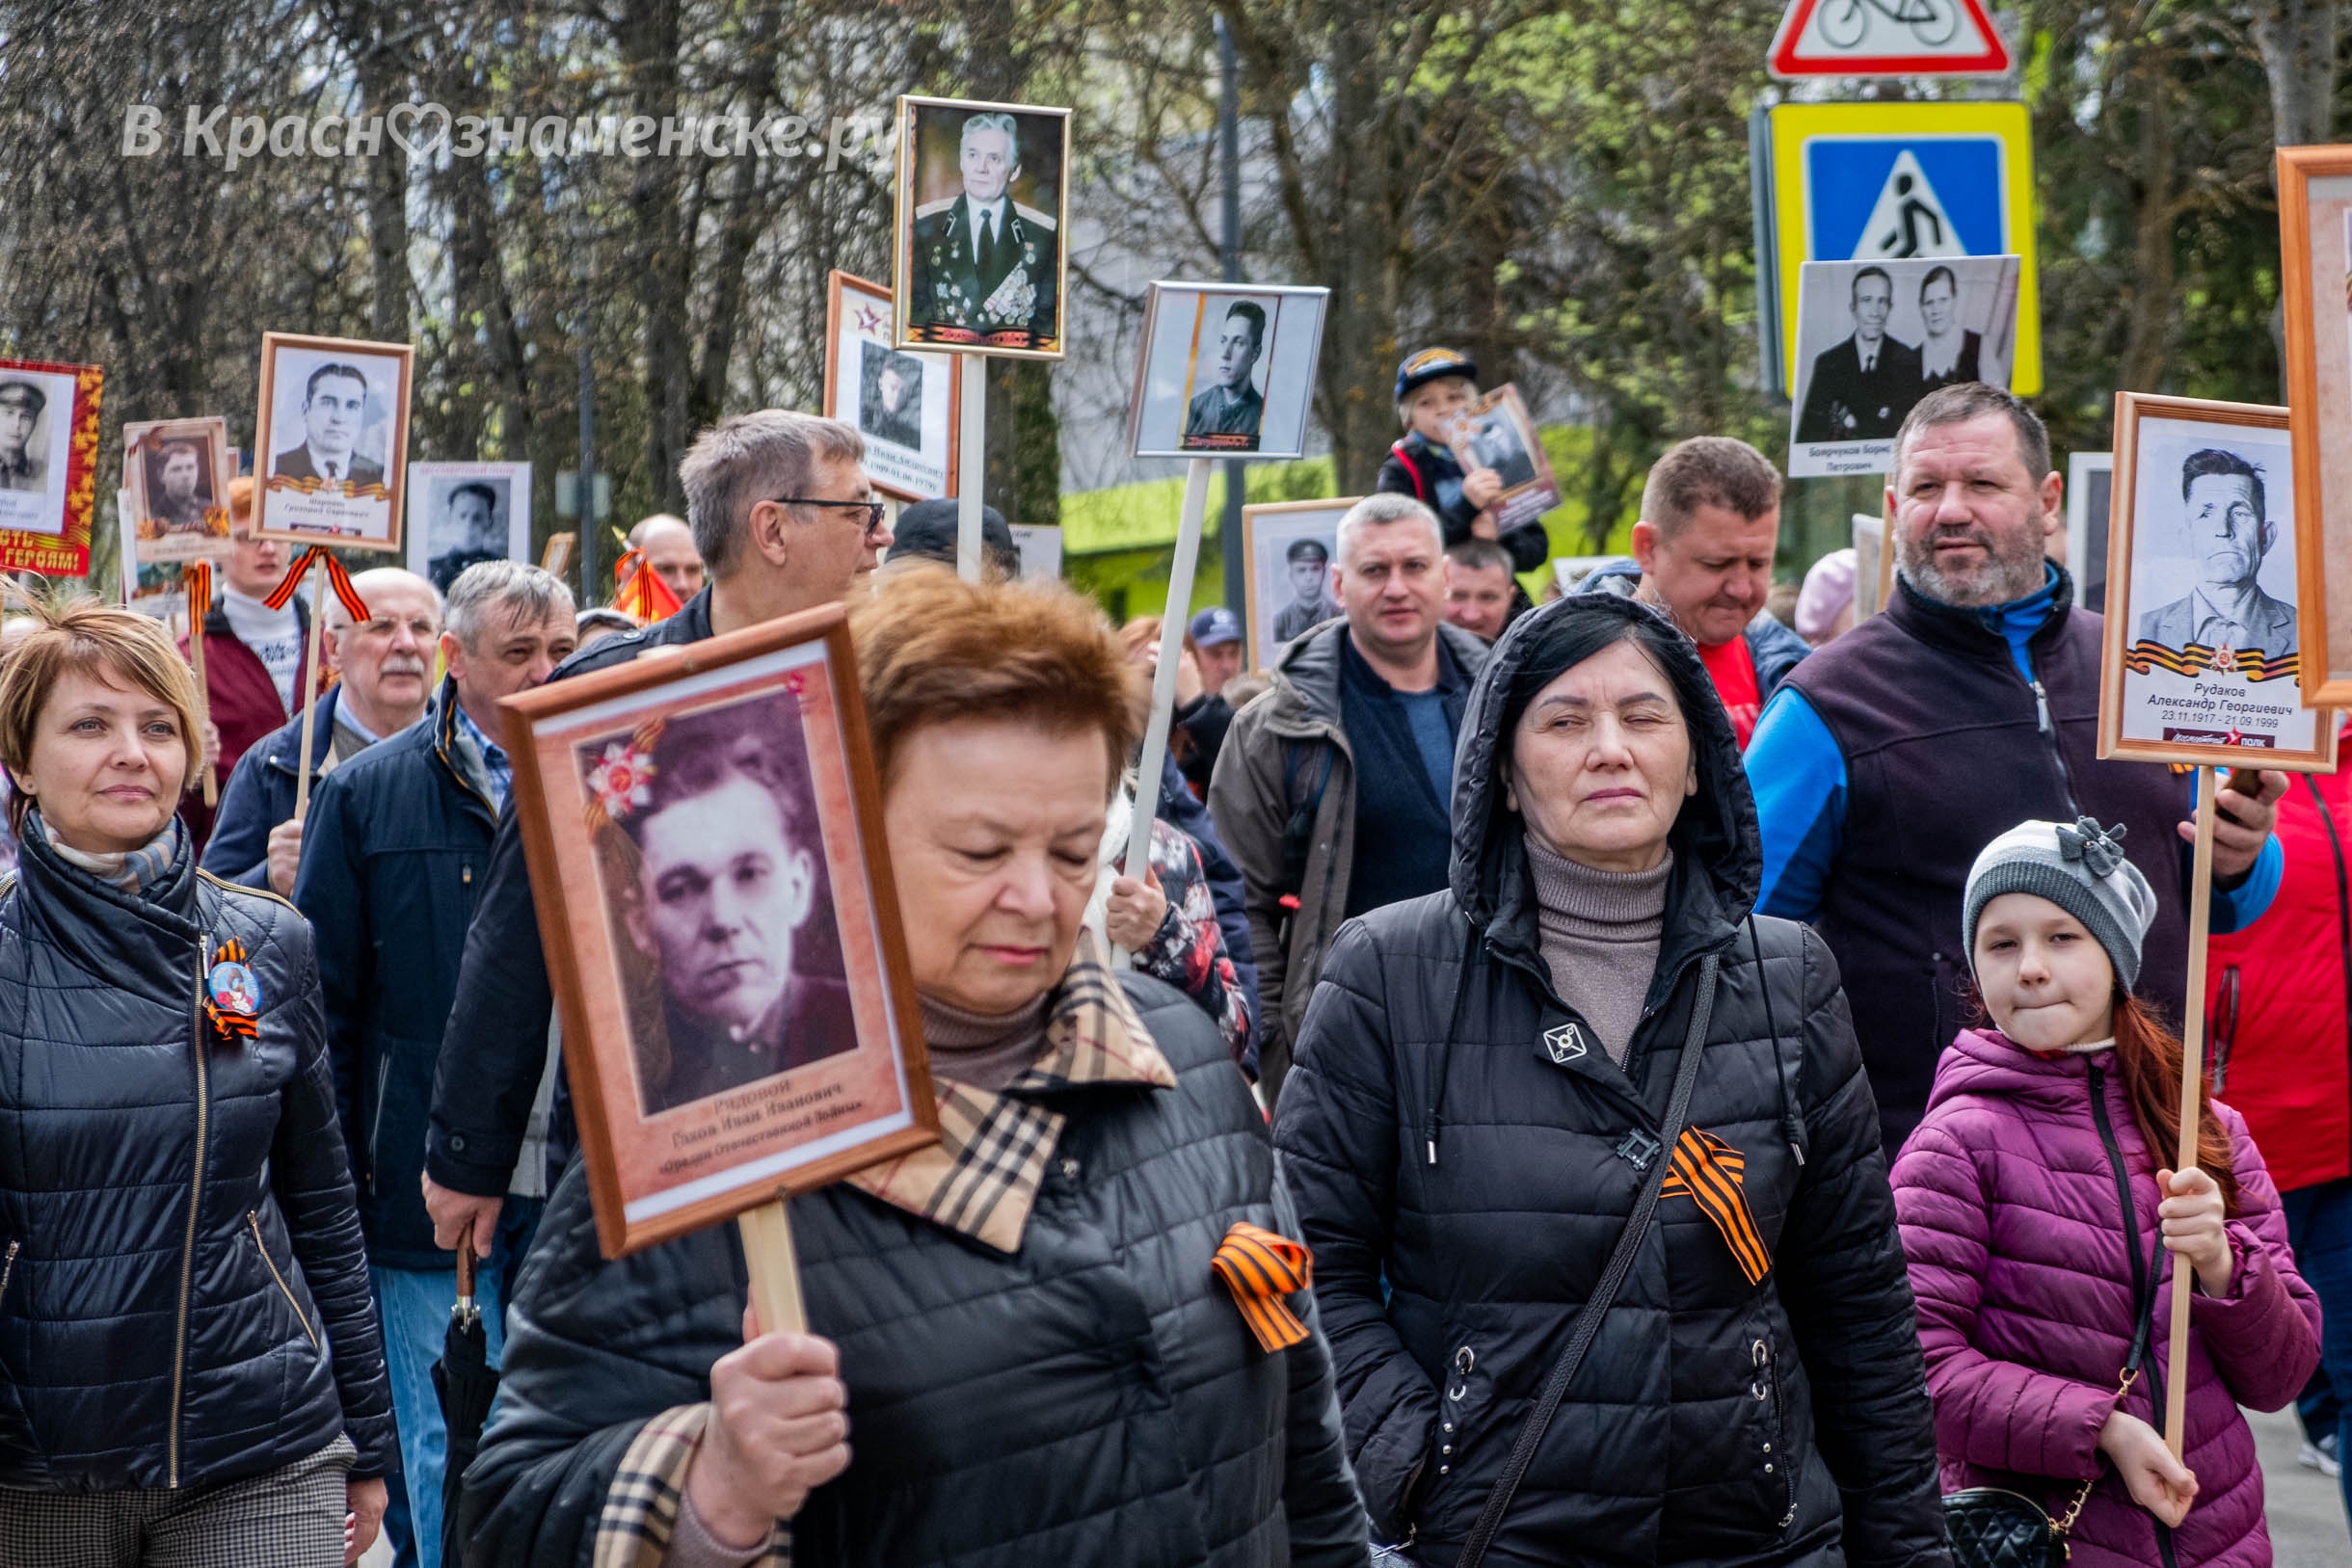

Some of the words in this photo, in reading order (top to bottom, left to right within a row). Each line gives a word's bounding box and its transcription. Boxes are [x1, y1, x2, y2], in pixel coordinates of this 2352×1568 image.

[5, 547, 79, 571] ГЕРОЯМ!
[2194, 682, 2246, 698] Рудаков
[2148, 695, 2216, 710] Александр
[2219, 700, 2292, 716] Георгиевич
[2161, 710, 2215, 723] 23.11.1917
[2225, 715, 2278, 729] 21.09.1999
[722, 1110, 762, 1130] Иван
[766, 1082, 842, 1117] Иванович
